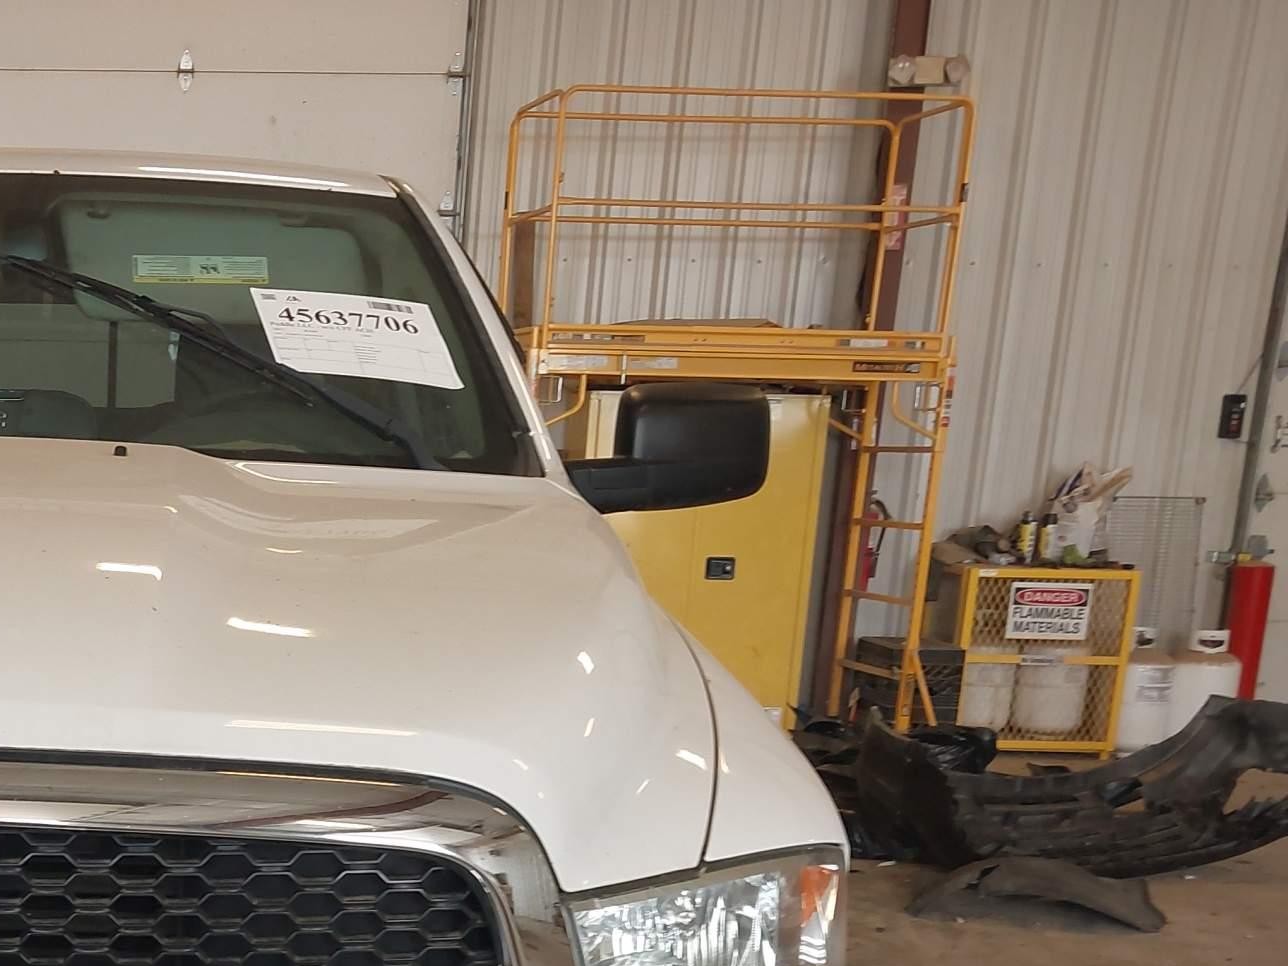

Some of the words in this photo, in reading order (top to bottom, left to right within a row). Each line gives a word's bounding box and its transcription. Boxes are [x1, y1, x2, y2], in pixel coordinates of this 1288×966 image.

[278, 306, 419, 335] 45637706
[1023, 591, 1079, 603] DANGER
[1012, 606, 1085, 620] FLAMMABLE
[1012, 620, 1081, 634] MATERIALS
